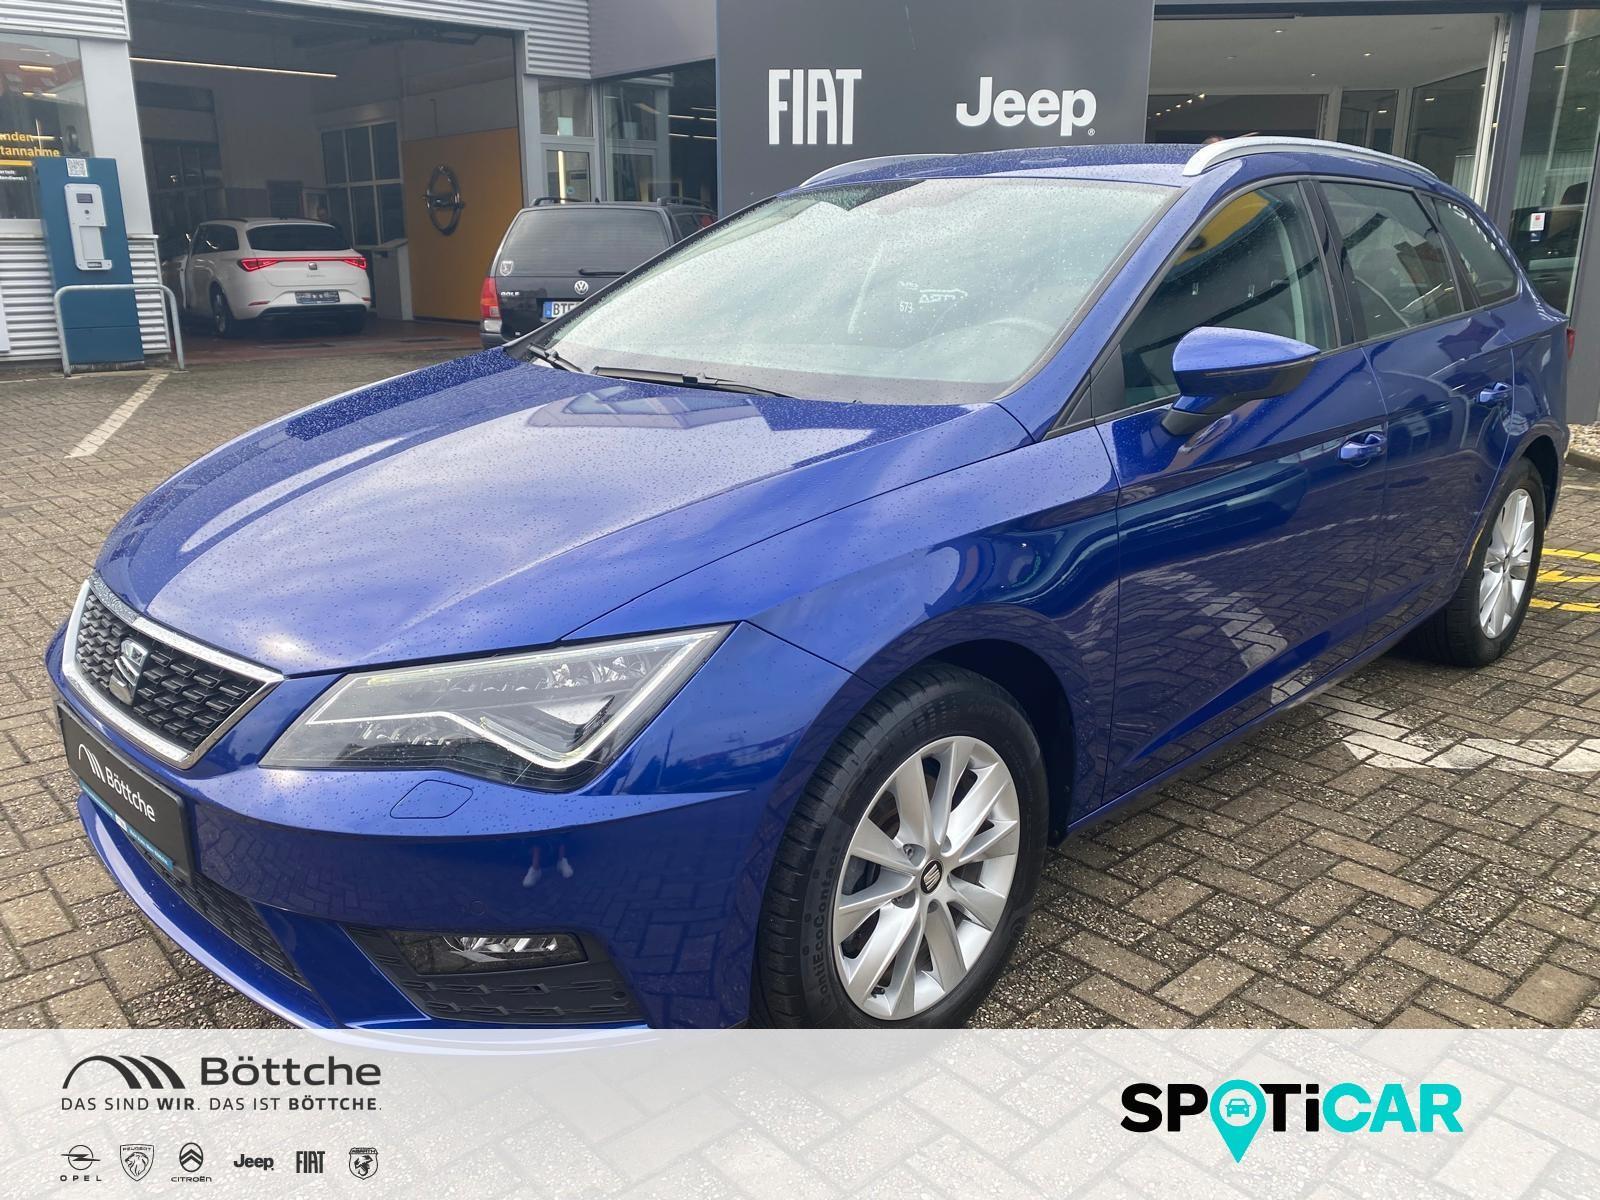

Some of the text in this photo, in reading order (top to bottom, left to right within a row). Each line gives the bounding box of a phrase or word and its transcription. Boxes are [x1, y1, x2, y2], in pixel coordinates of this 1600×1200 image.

[769, 69, 862, 145] FIAT
[956, 76, 1097, 136] Jeep
[105, 766, 156, 823] Böttche
